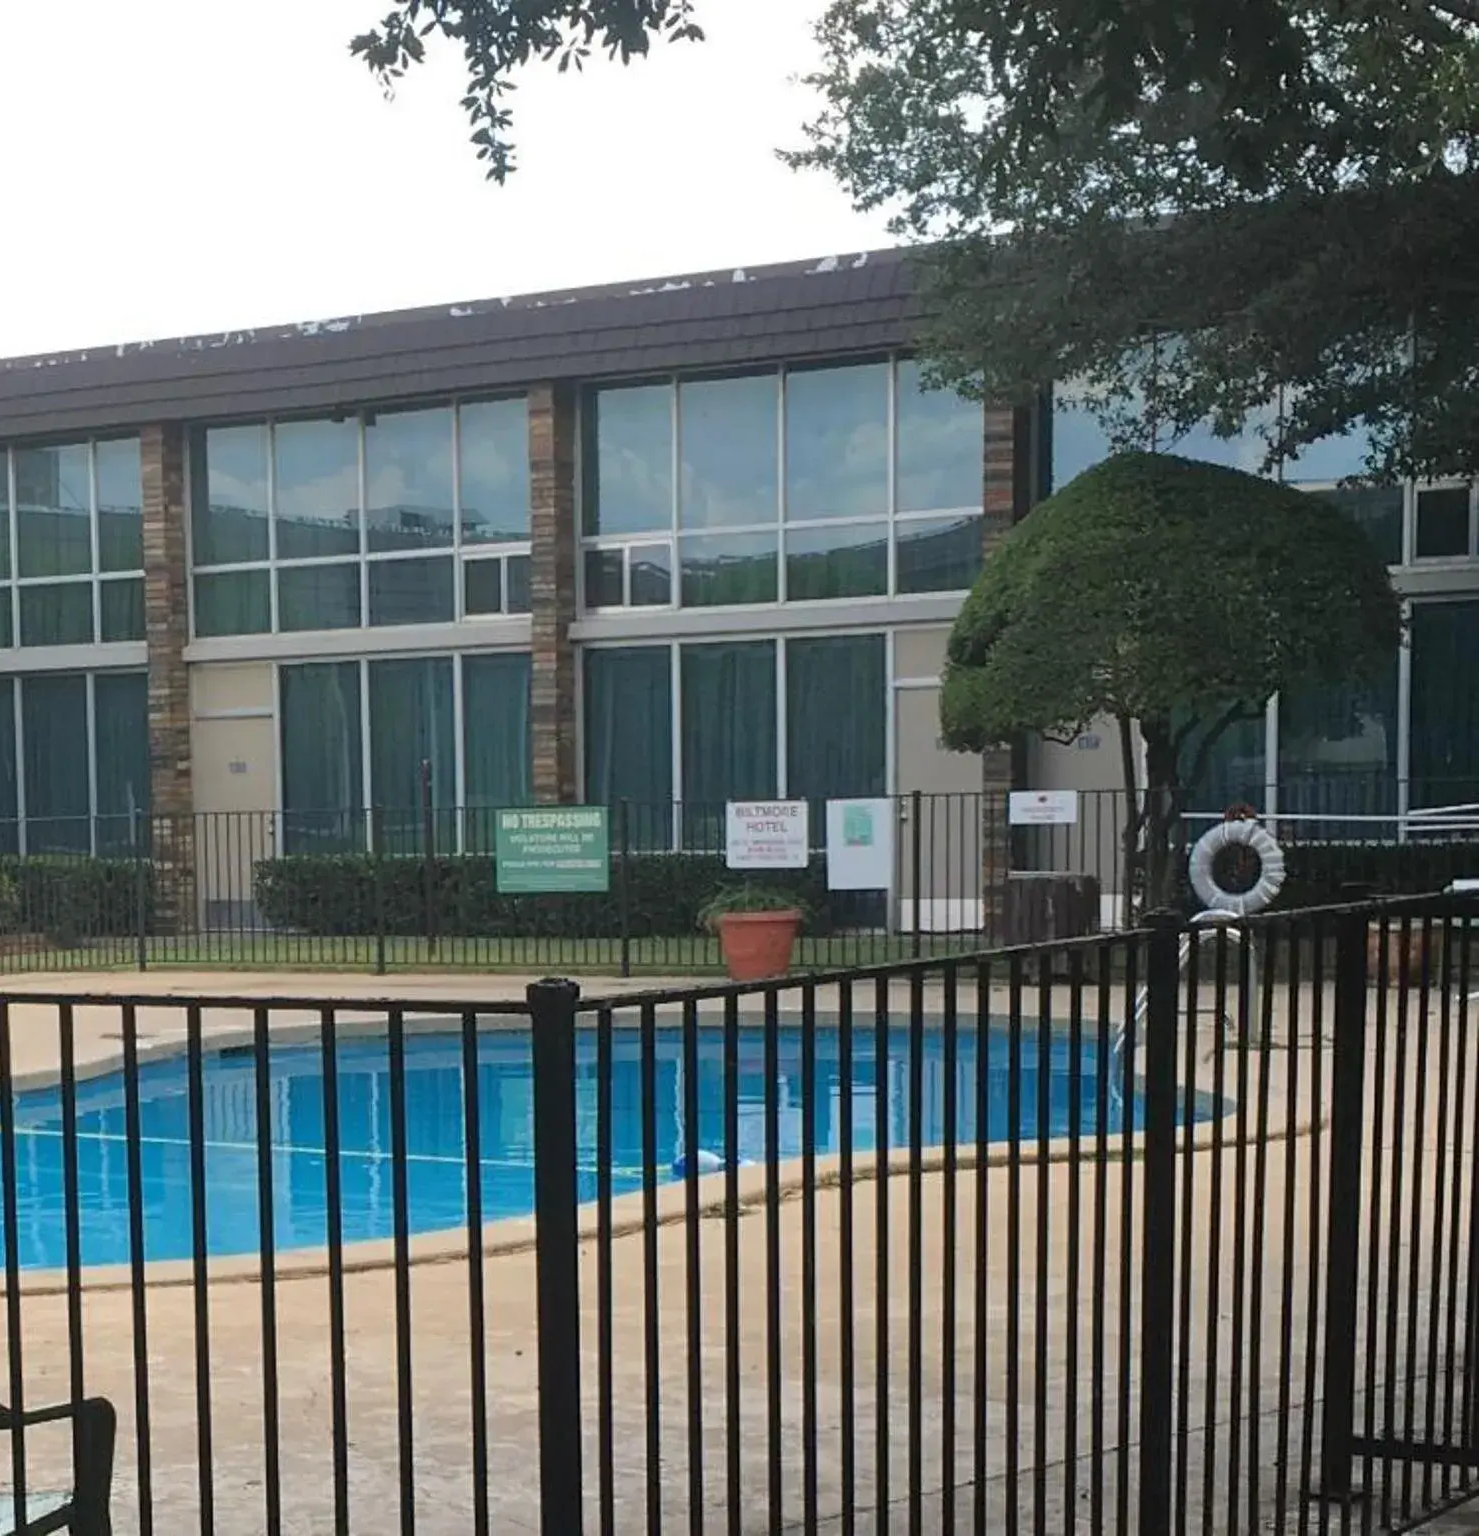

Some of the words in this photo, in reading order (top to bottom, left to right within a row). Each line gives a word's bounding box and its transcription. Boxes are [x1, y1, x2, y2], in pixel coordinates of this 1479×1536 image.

[735, 806, 799, 817] BILTMORE
[502, 813, 520, 829] NO
[521, 811, 602, 829] TRESPASSING
[746, 821, 789, 833] HOTEL
